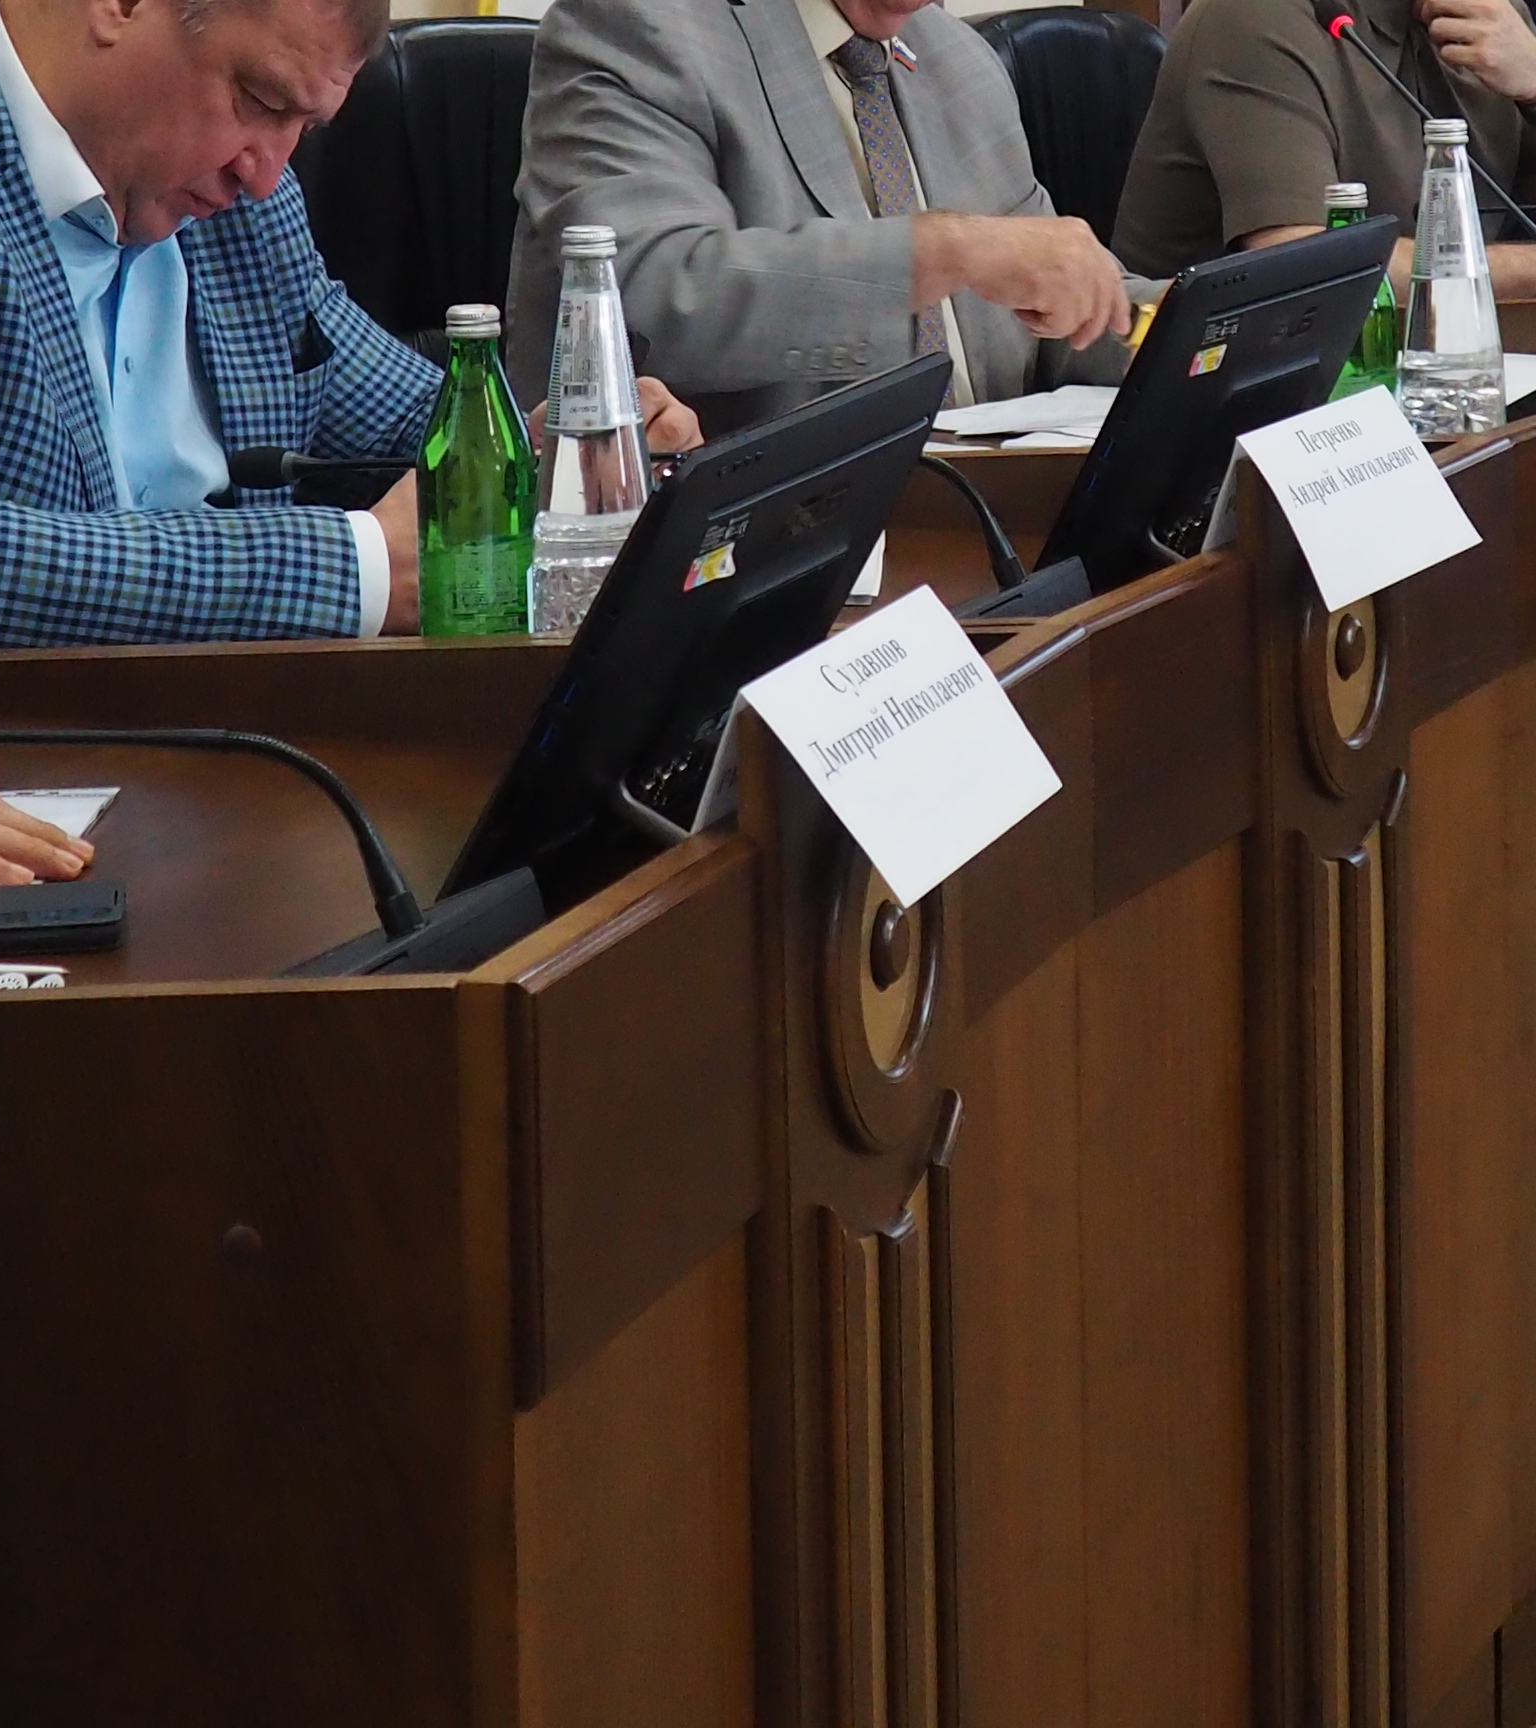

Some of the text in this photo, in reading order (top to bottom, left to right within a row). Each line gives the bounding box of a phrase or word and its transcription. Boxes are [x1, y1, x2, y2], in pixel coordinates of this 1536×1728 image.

[1294, 419, 1362, 454] Петренко
[1287, 445, 1419, 508] Андрей Анатольевич
[819, 639, 908, 696] Судавцов
[808, 706, 894, 782] Дмитрий
[883, 661, 983, 731] Николаевич
